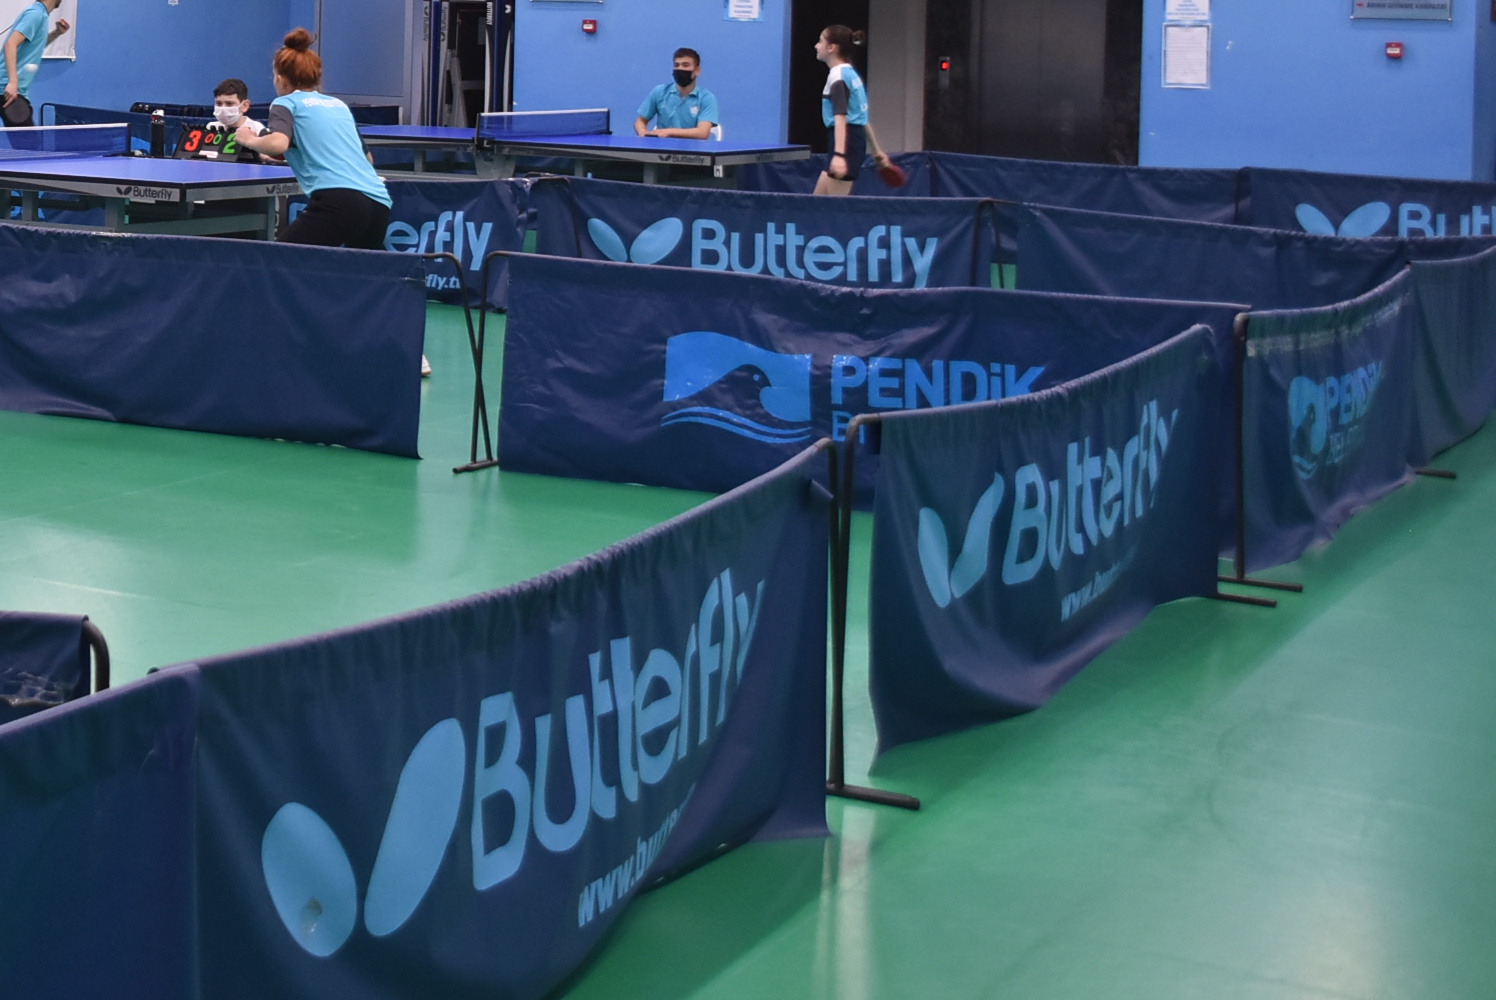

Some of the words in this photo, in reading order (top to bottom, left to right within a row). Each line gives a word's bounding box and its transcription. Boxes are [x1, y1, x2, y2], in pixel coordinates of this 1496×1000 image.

[185, 130, 202, 151] 3
[223, 132, 238, 153] 2
[133, 187, 172, 199] Butterfly
[691, 219, 938, 288] Butterfly
[1002, 400, 1178, 586] Butterfly
[471, 567, 765, 892] Butterfly
